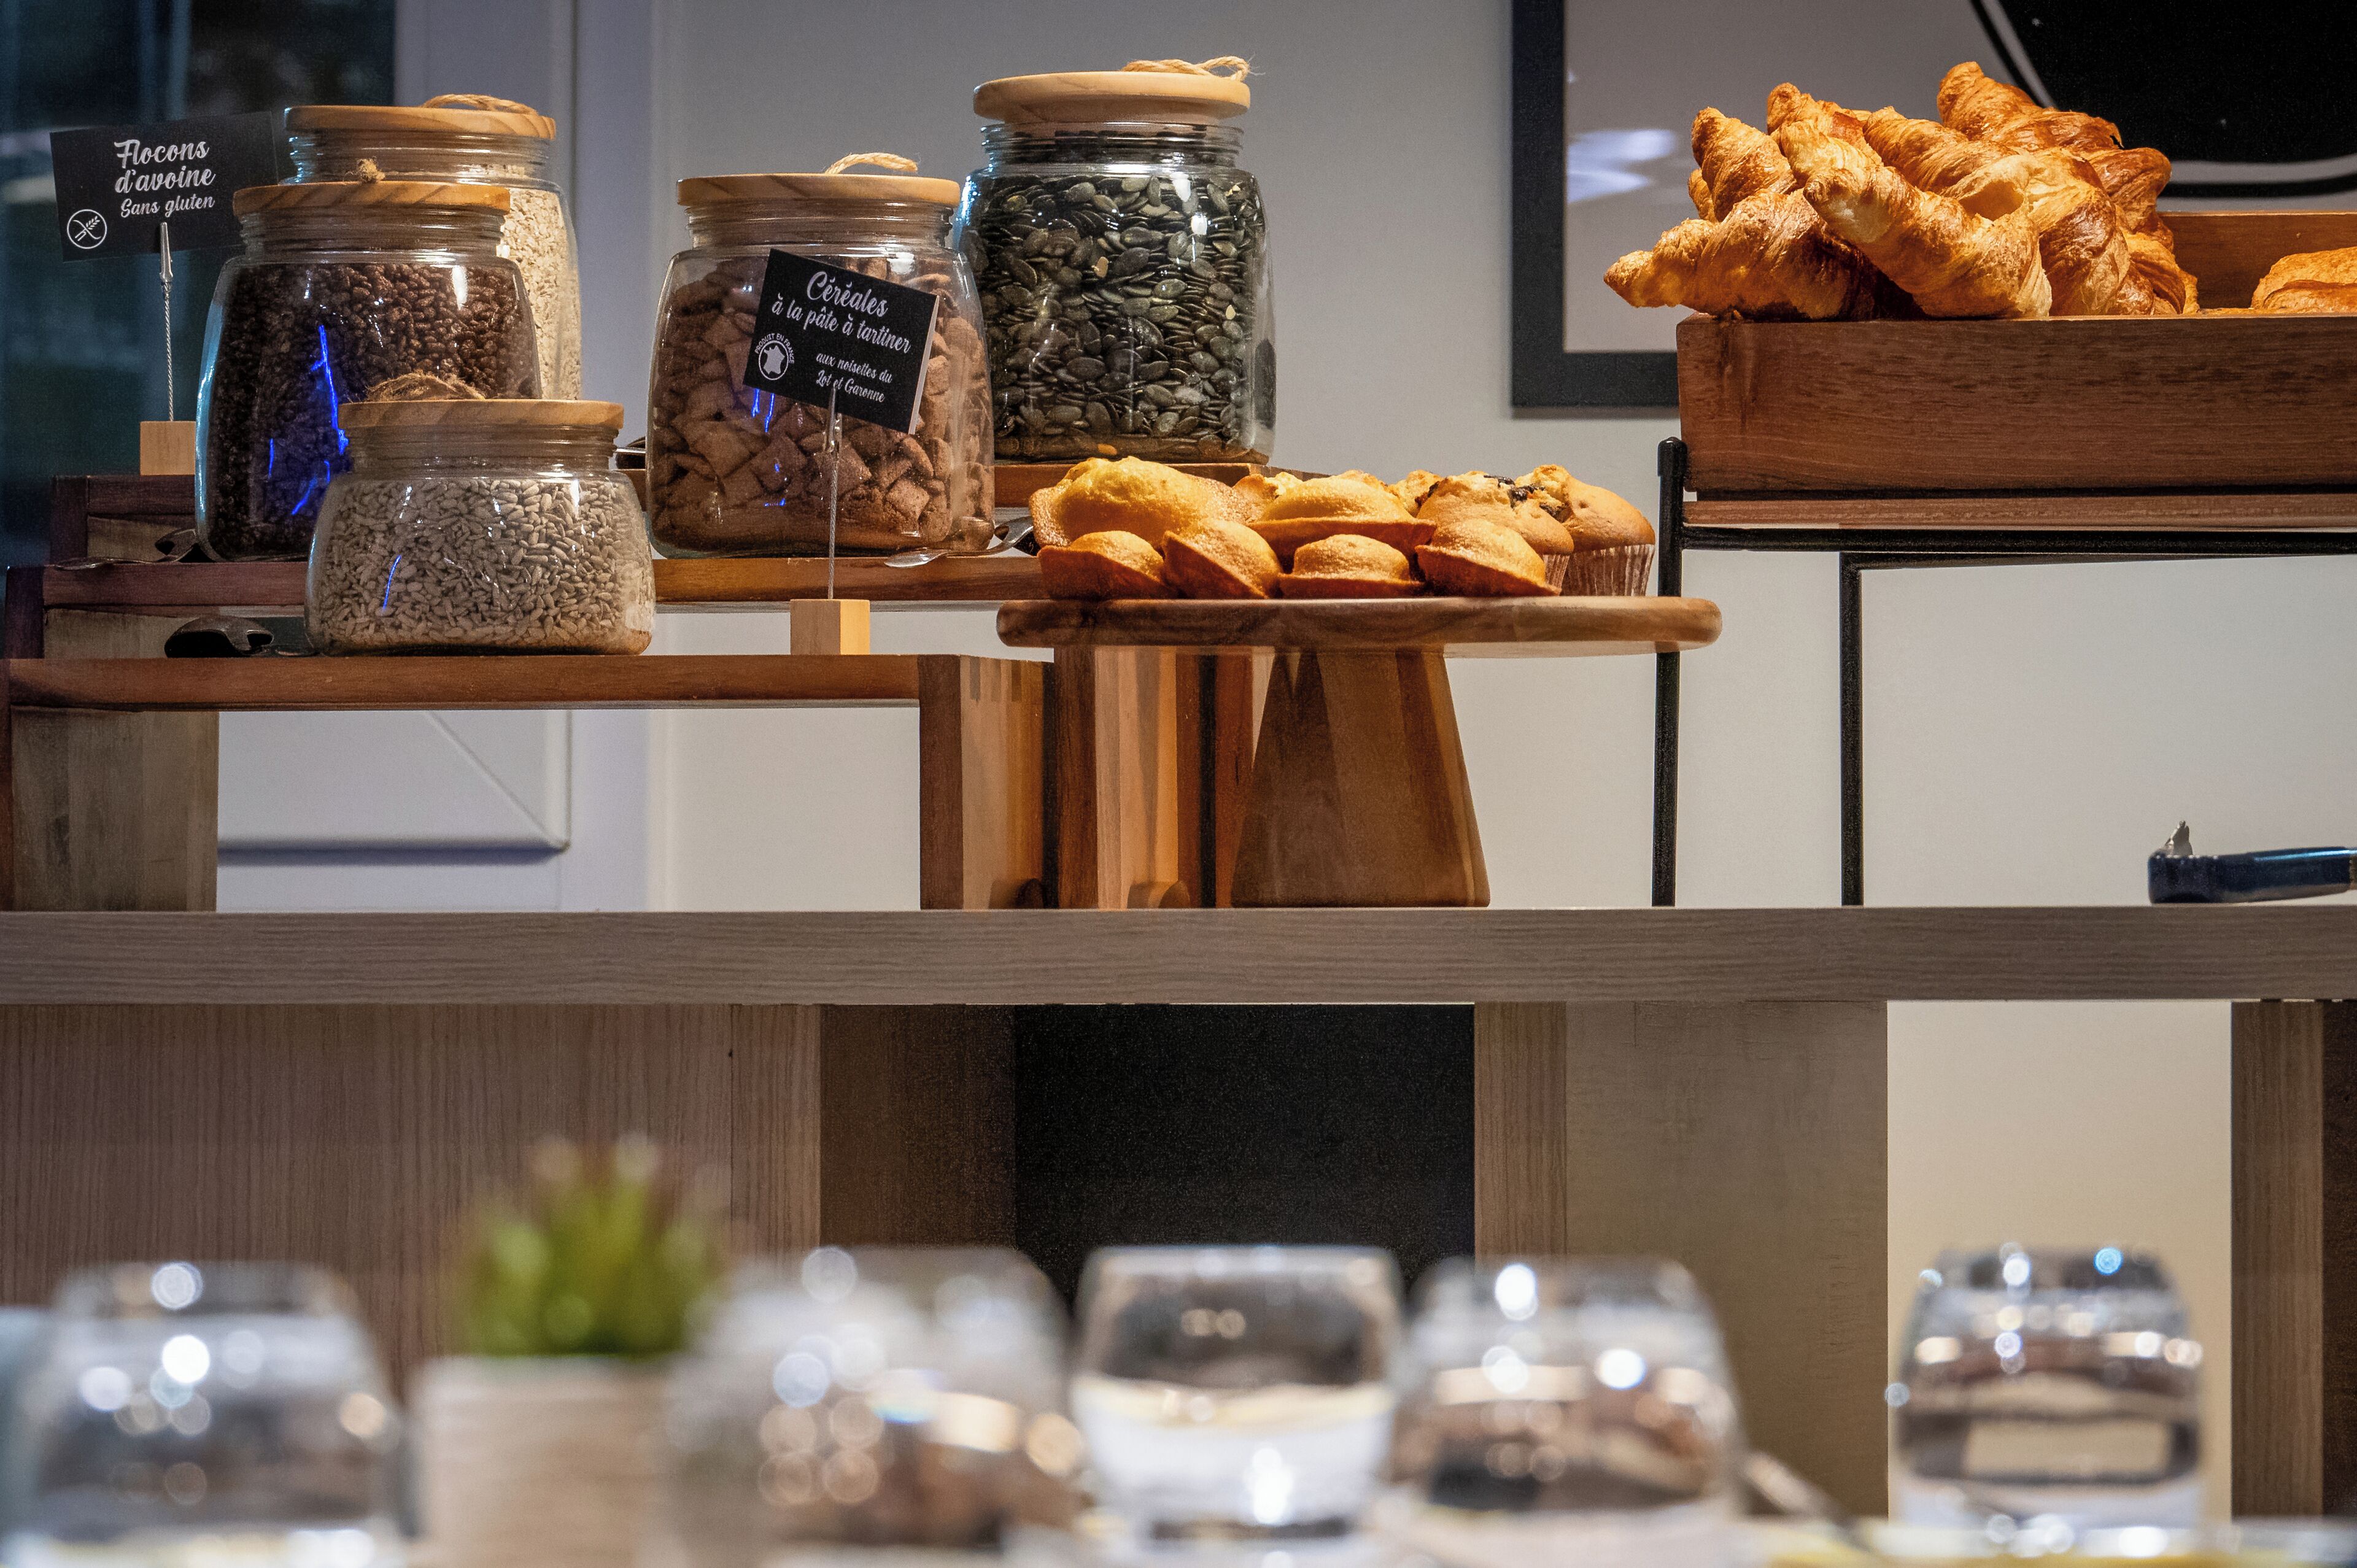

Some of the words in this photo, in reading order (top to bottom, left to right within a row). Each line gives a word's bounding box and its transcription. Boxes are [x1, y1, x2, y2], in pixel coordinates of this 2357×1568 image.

[114, 139, 210, 169] Flocons
[120, 198, 160, 218] Sans
[164, 193, 215, 218] gluten
[807, 271, 888, 317] Céréales
[772, 293, 783, 315] à
[787, 299, 803, 321] la
[803, 306, 839, 332] pâte
[842, 314, 854, 336] à
[857, 320, 911, 354] tartiner
[754, 333, 775, 354] PRODUIT
[776, 333, 784, 341] EN
[783, 338, 795, 364] FRANCE
[816, 353, 837, 367] aux
[837, 358, 878, 379] noisettes
[879, 369, 893, 384] du
[816, 369, 833, 387] Lot
[833, 377, 844, 390] et
[844, 378, 885, 403] Garonne
